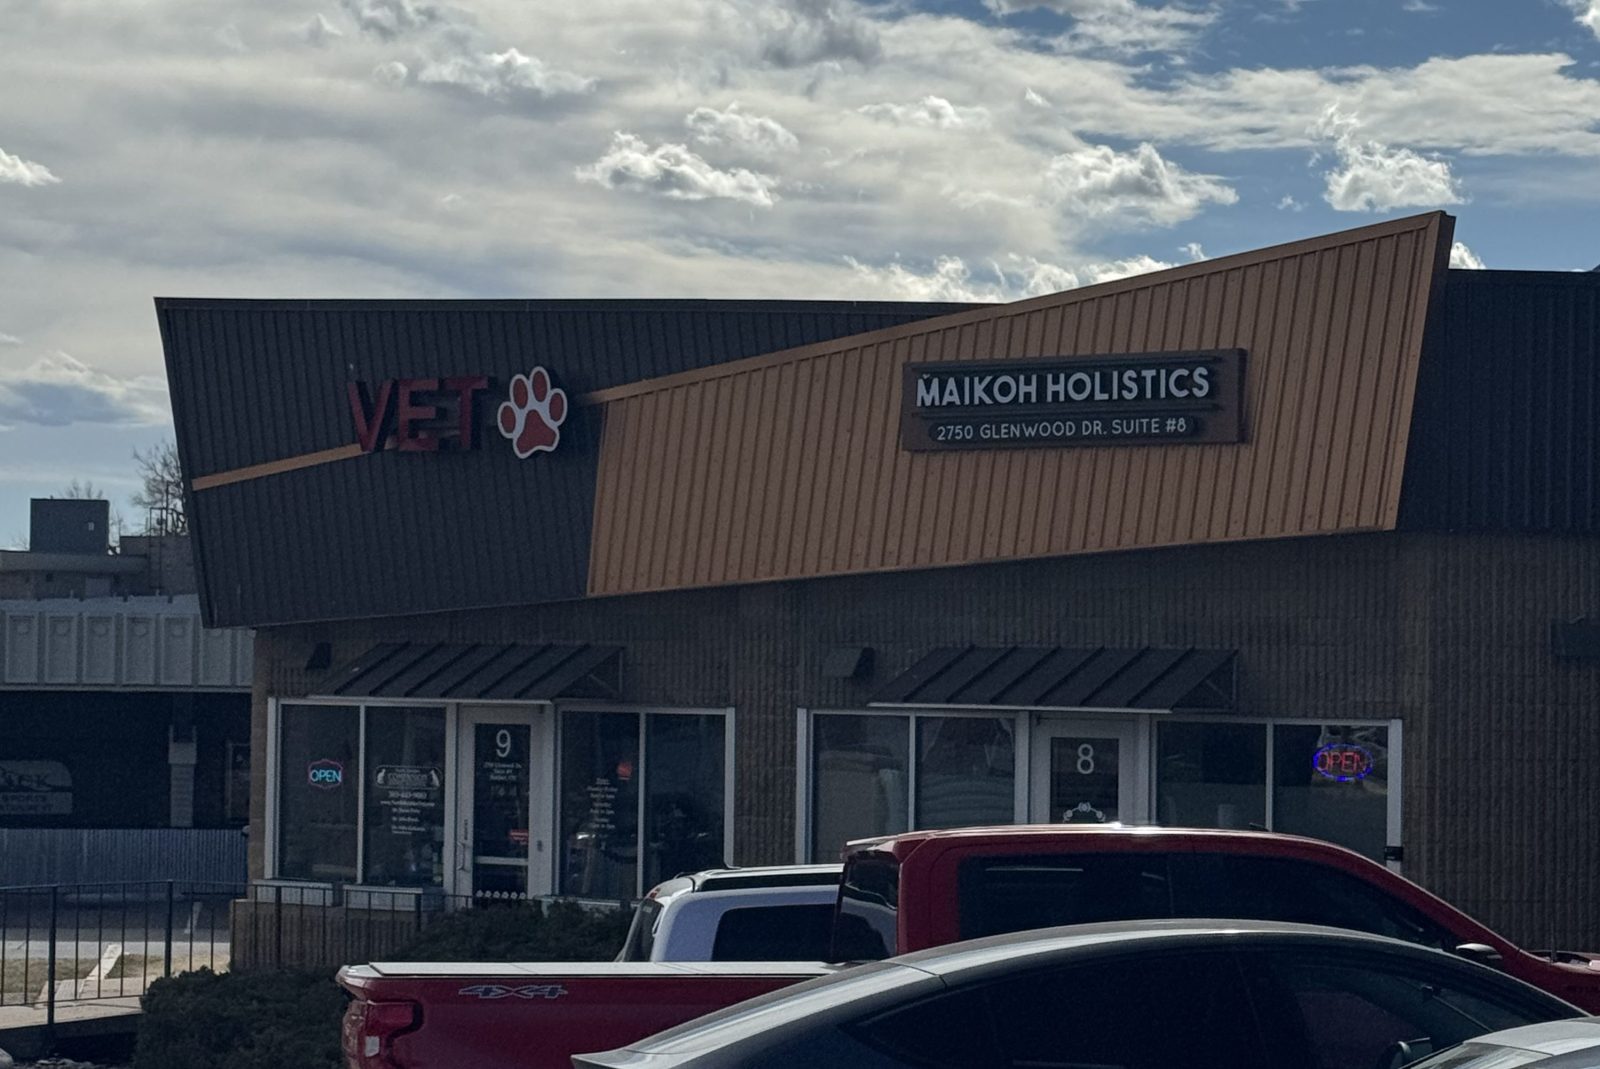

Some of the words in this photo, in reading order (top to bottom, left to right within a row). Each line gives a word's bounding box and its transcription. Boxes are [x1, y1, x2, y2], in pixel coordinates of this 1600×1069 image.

[916, 374, 1037, 407] MAIKOH
[1046, 367, 1210, 402] HOLISTICS
[348, 376, 488, 453] VET
[936, 424, 974, 441] 2750
[980, 421, 1076, 439] GLENWOOD
[1082, 420, 1107, 437] DR.
[1111, 418, 1160, 435] SUITE
[1165, 417, 1187, 433] #8
[494, 729, 512, 758] 9
[1076, 743, 1095, 775] 8
[1317, 751, 1367, 773] OPEN
[309, 768, 342, 784] OPEN
